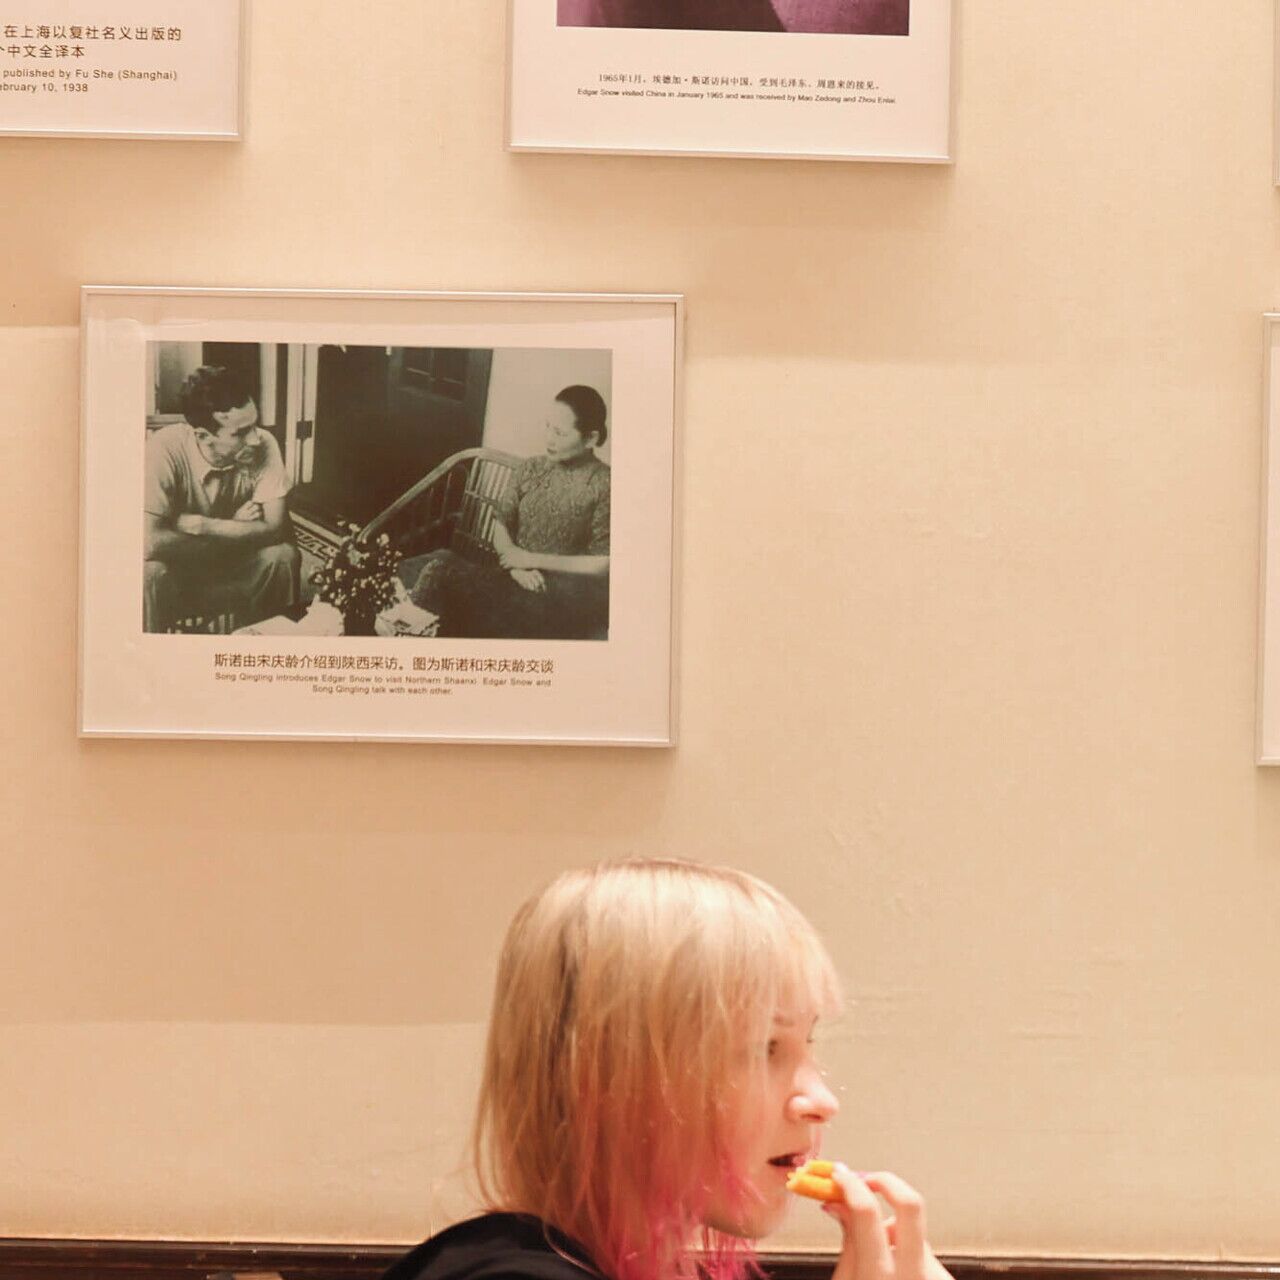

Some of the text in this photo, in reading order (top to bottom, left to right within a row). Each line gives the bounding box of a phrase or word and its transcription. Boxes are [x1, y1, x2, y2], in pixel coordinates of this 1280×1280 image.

[4, 24, 182, 42] 在上海以复社名义出版的
[3, 69, 177, 81] published by Fu She (Shanghai)
[63, 83, 88, 92] 1938
[815, 95, 842, 103] Zedong
[215, 672, 237, 682] Song
[239, 672, 273, 682] Qingling
[276, 674, 319, 682] introduces
[321, 674, 346, 684] Edgar
[350, 675, 372, 683] Snow
[405, 676, 441, 684] Northern
[482, 677, 507, 687] Edgar
[510, 678, 533, 686] Snow
[312, 685, 334, 694] Song
[336, 685, 370, 695] Qingling
